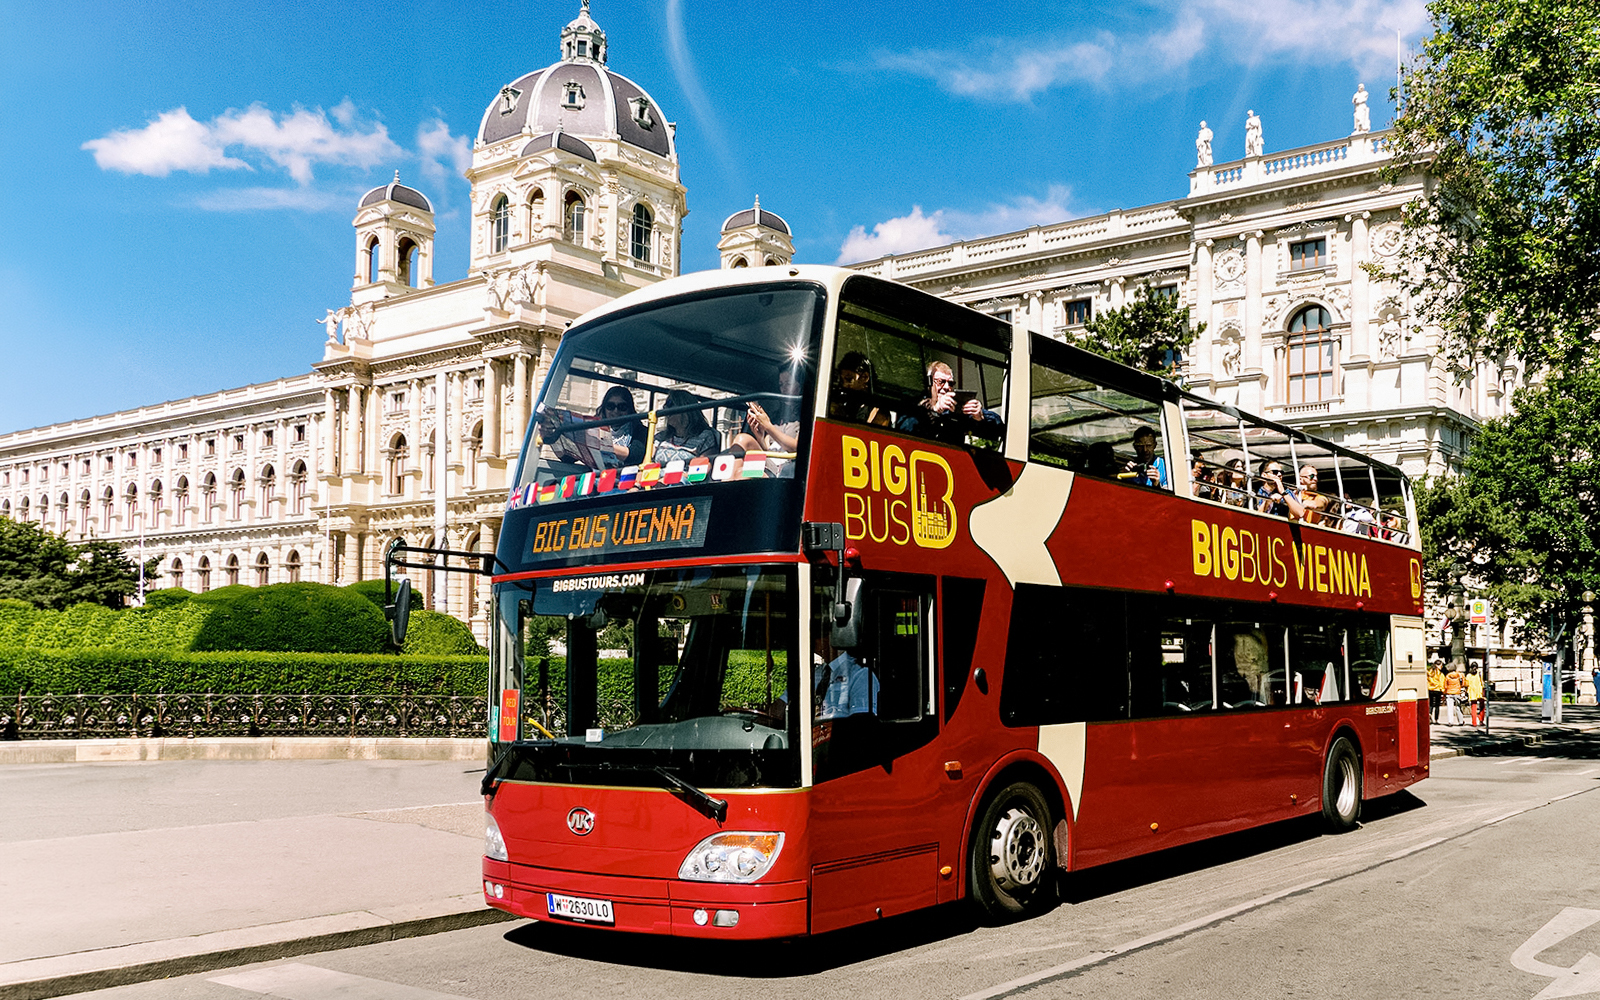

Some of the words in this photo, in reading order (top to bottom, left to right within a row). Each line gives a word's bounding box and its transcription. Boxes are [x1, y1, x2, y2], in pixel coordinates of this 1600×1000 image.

[841, 434, 908, 496] BIG
[532, 519, 568, 554] BIG
[568, 513, 610, 551] BUS
[611, 503, 696, 546] VIENNA
[844, 492, 910, 546] BUS
[552, 572, 646, 593] BIGBUSTOURS.COM
[1291, 540, 1372, 599] VIENNA
[505, 697, 517, 708] RED
[502, 716, 517, 727] TOUR
[568, 899, 595, 916] 2630
